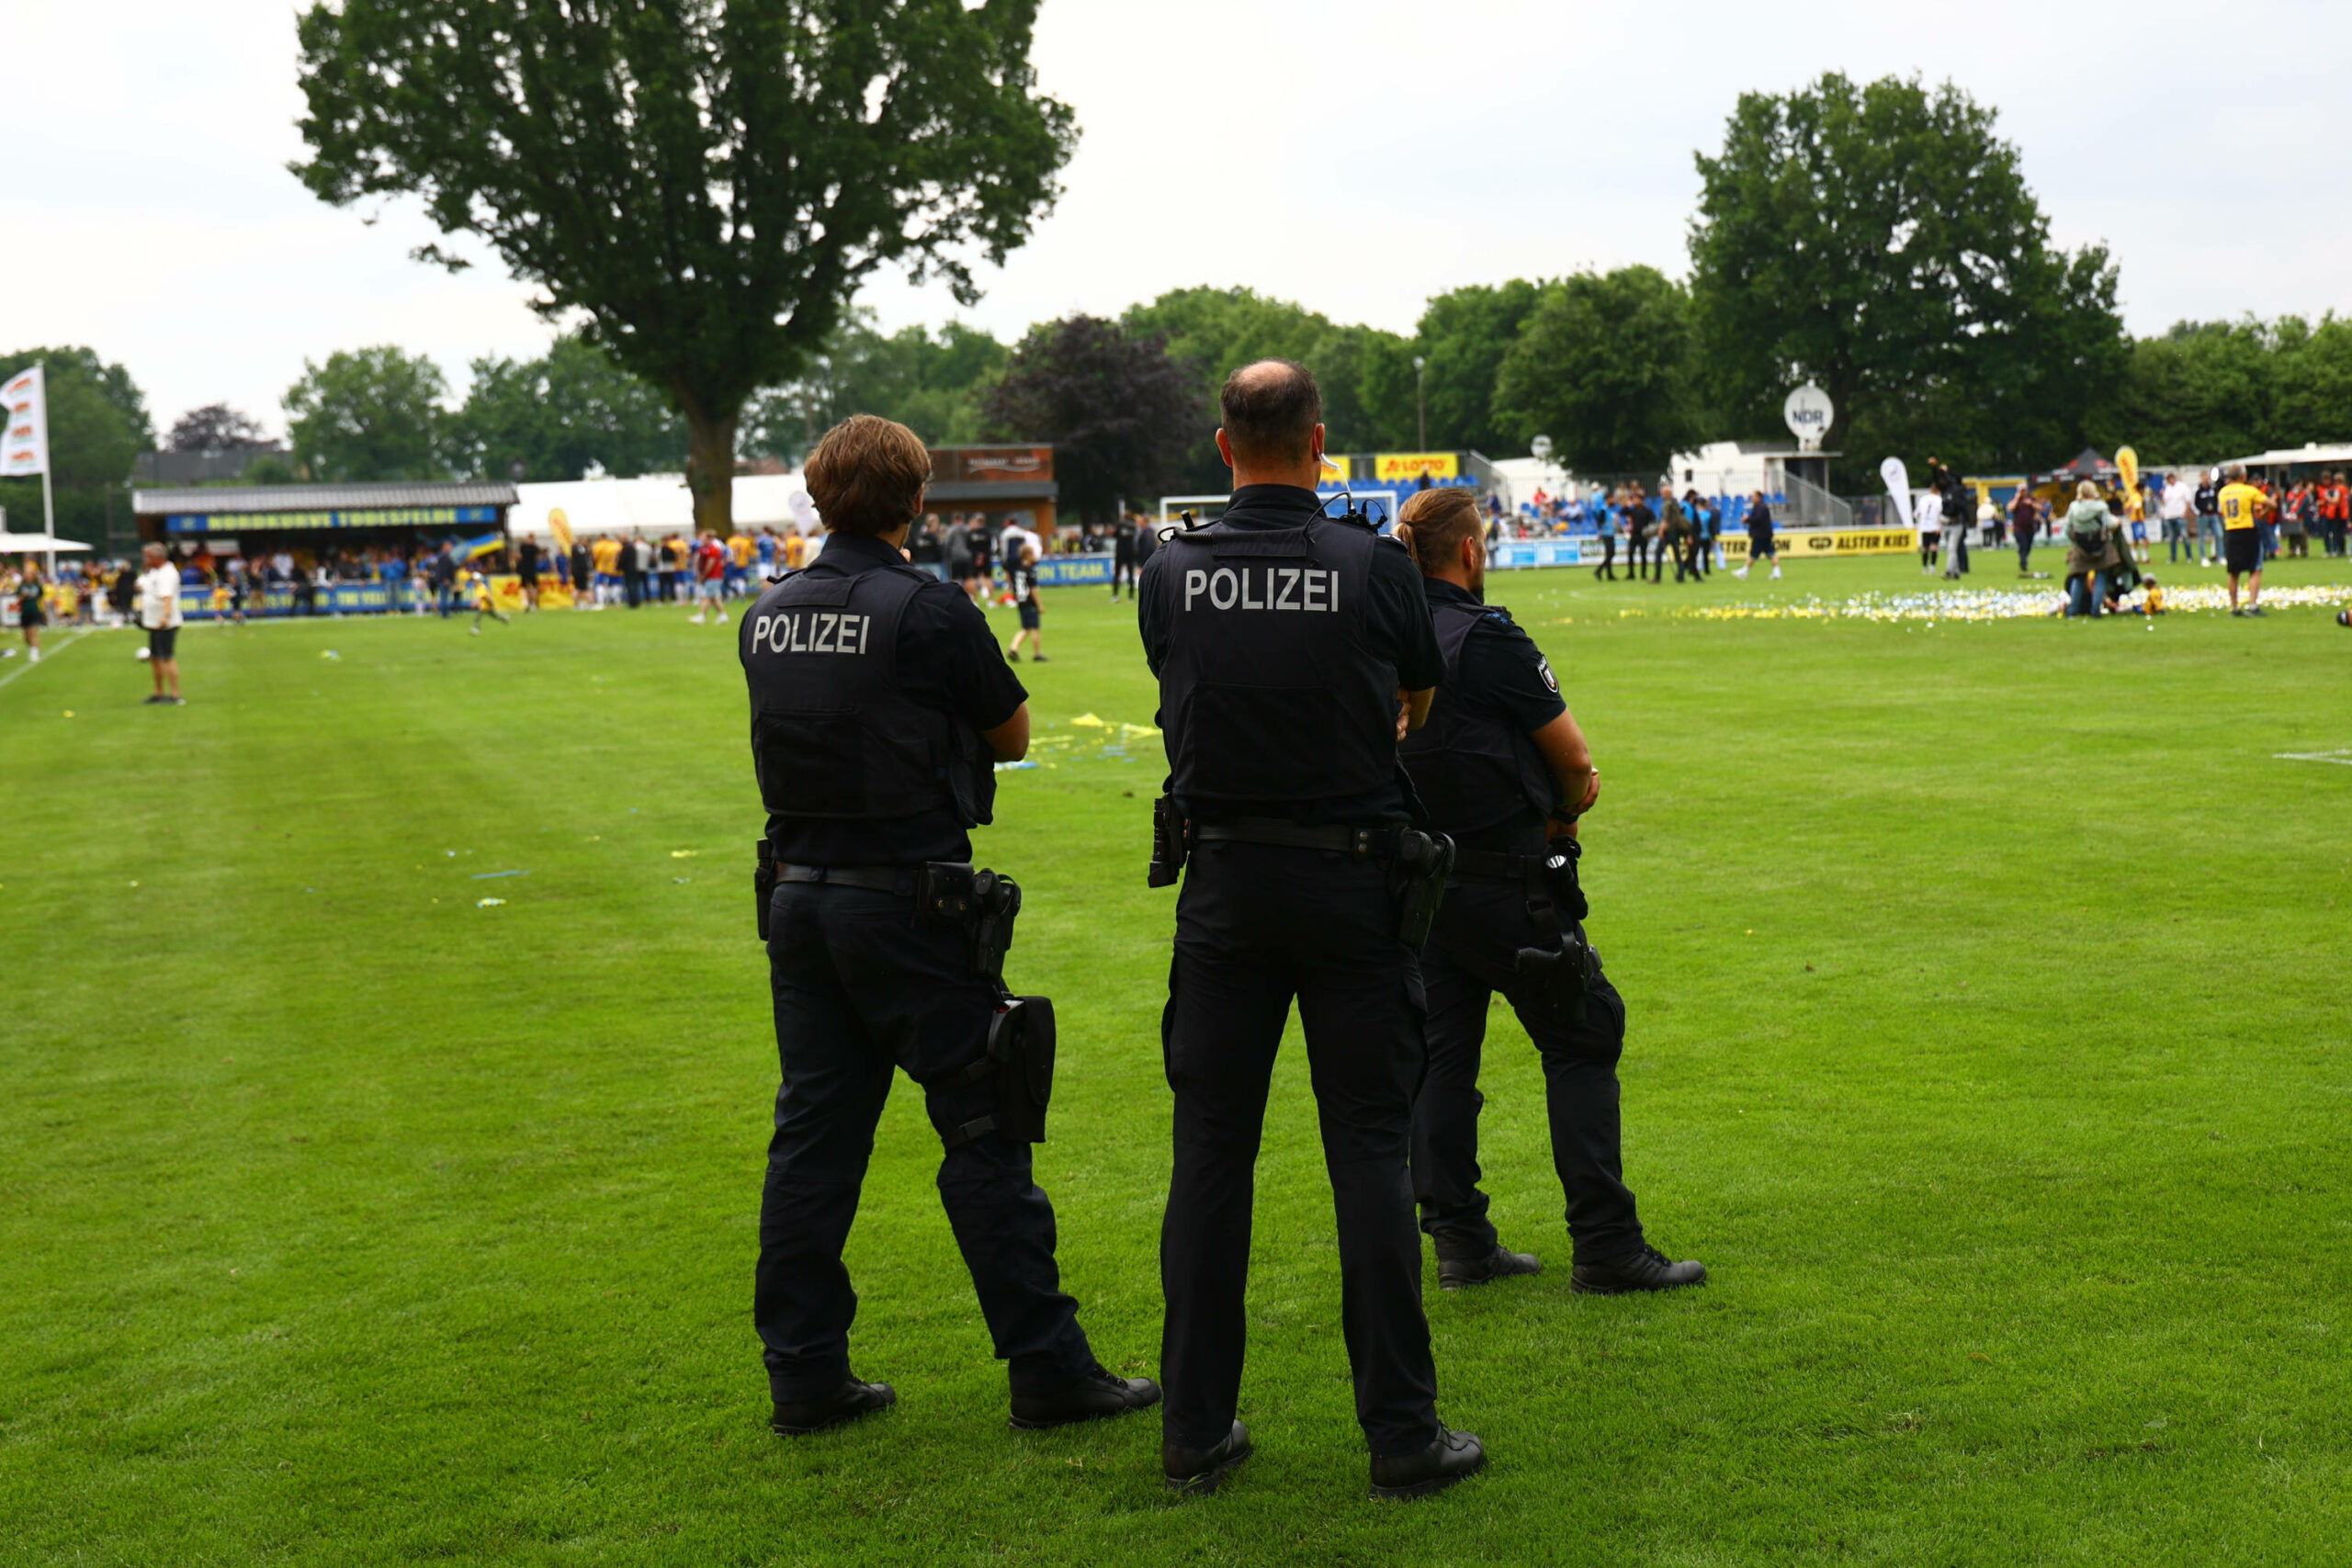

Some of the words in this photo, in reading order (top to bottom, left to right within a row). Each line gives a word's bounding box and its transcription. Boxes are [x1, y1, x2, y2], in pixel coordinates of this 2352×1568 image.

[1792, 410, 1824, 423] NDR
[1838, 536, 1880, 550] ALSTER
[1185, 568, 1339, 612] POLIZEI
[752, 613, 870, 654] POLIZEI
